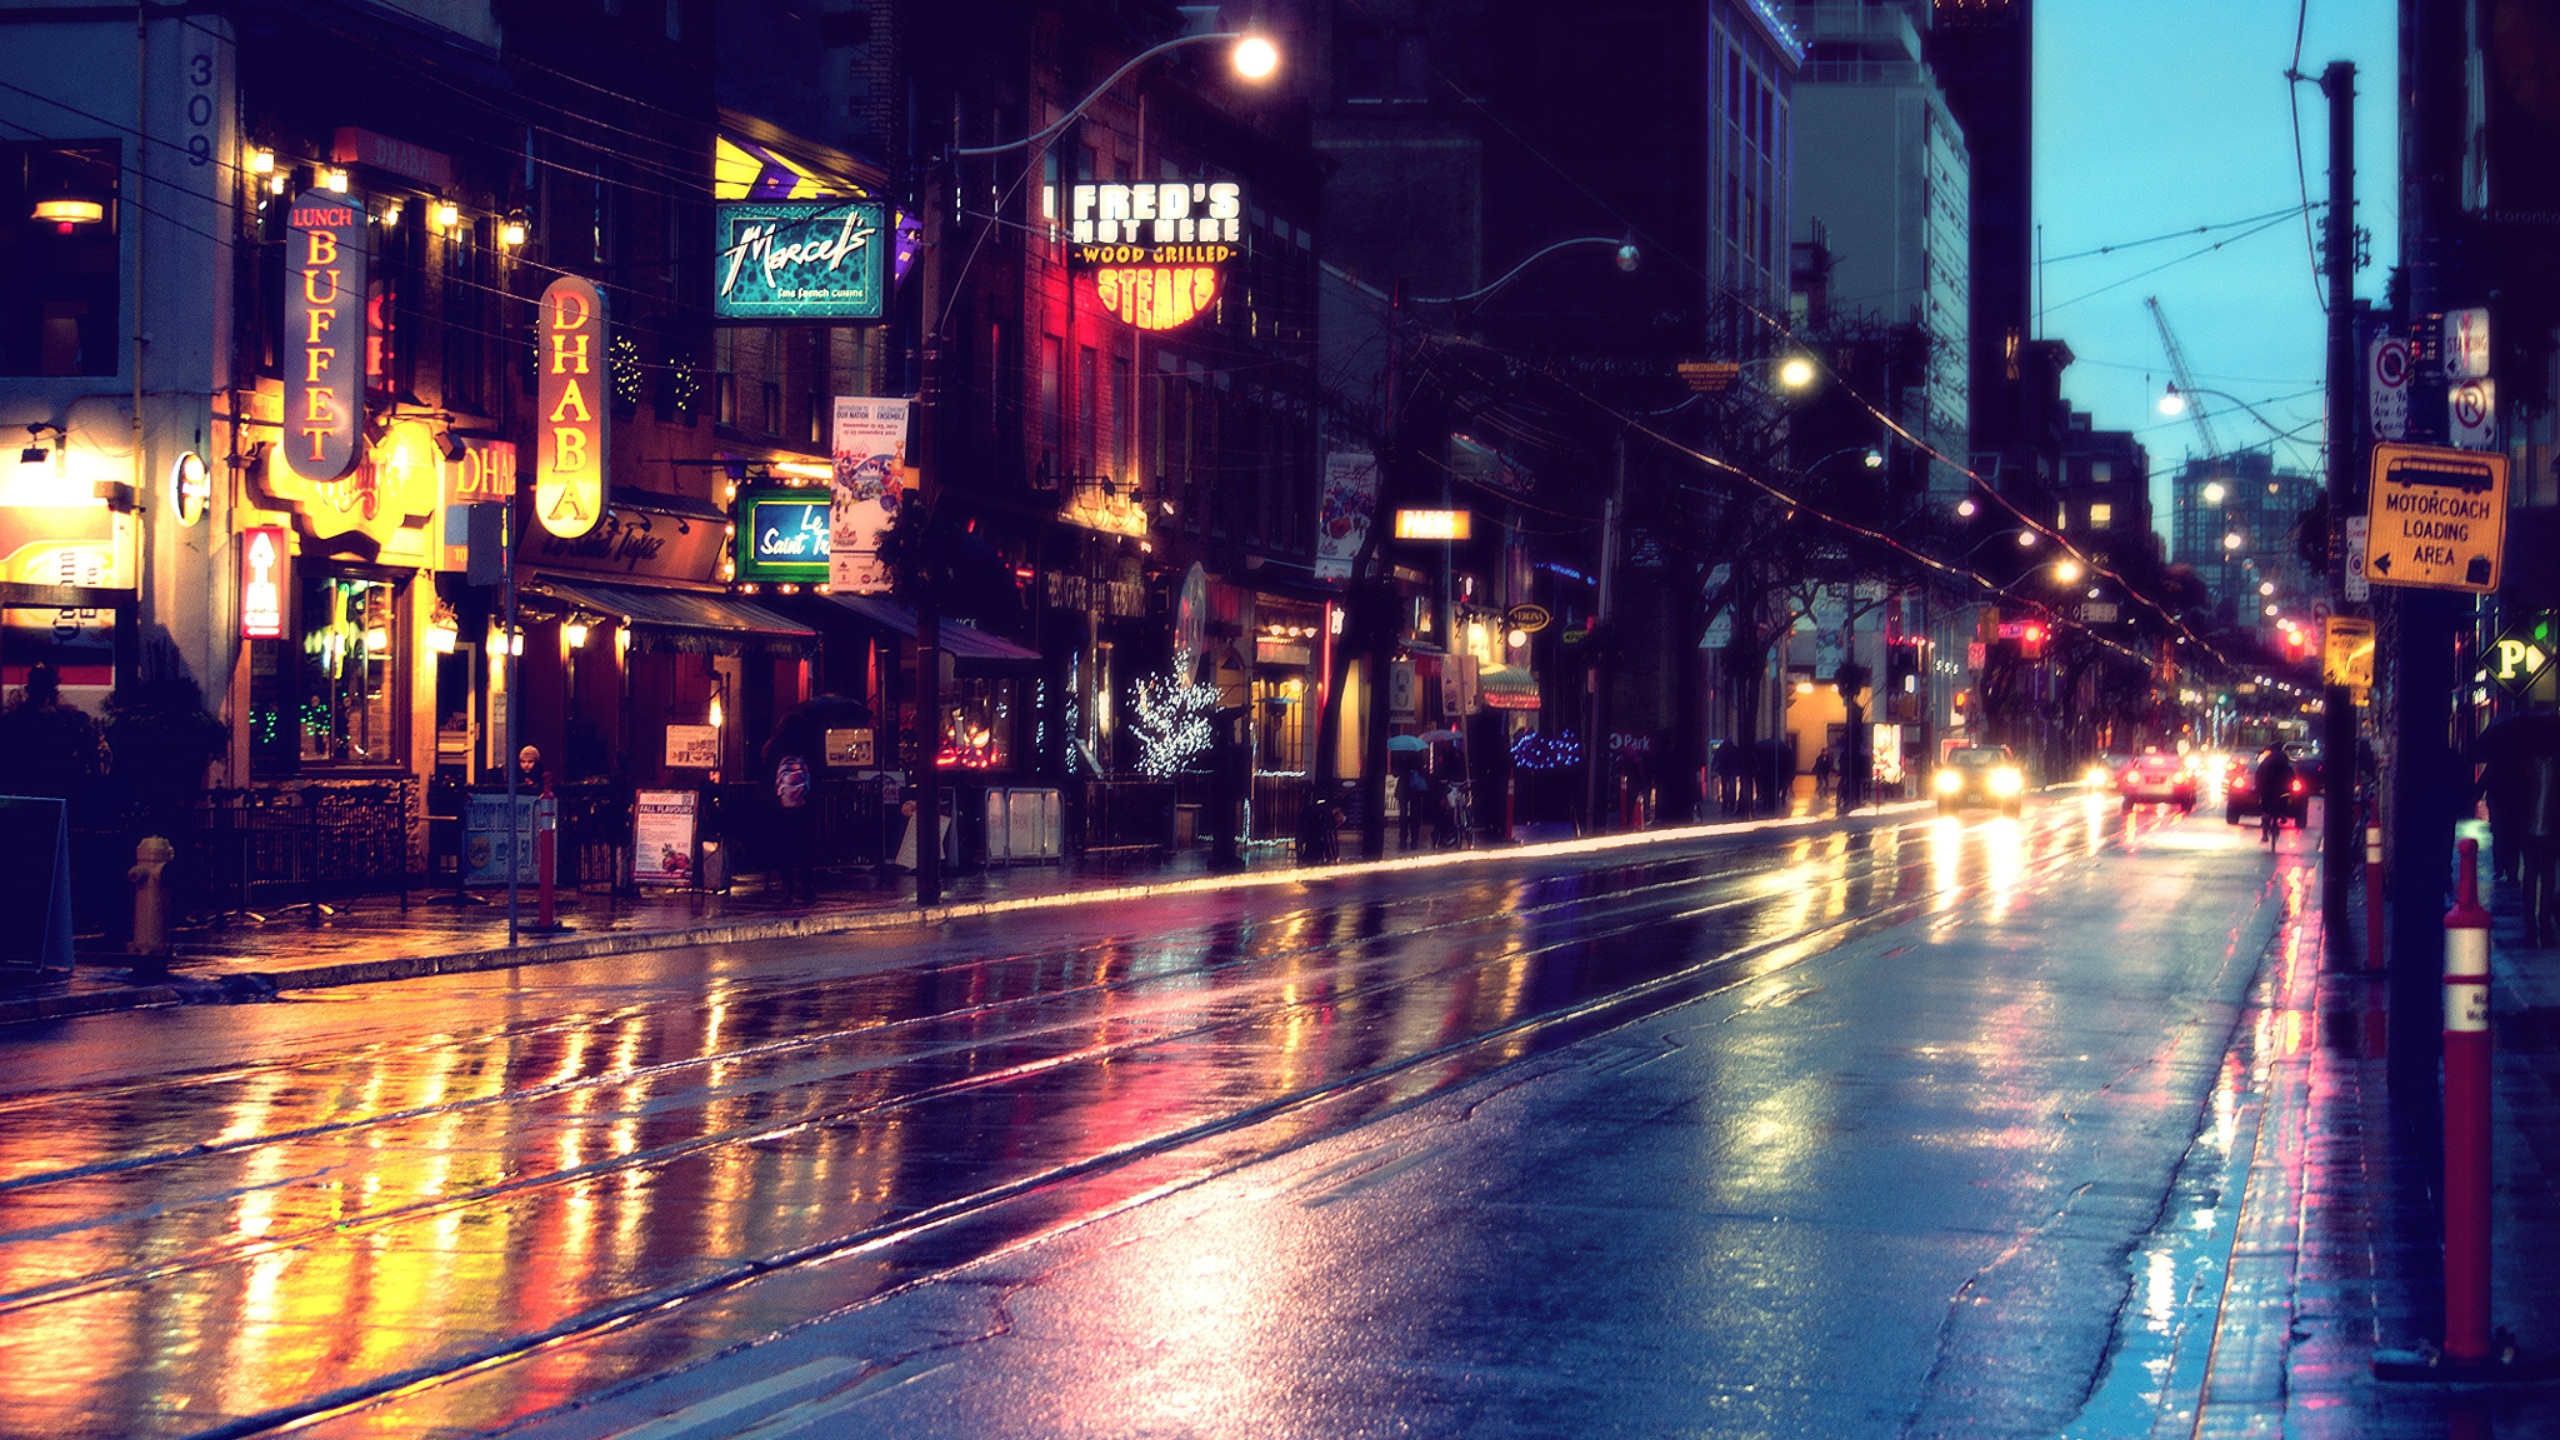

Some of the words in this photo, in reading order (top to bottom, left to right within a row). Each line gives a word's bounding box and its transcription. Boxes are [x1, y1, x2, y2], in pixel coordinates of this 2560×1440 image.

[188, 54, 214, 168] 309
[376, 136, 431, 179] DHABA
[1073, 182, 1241, 219] FRED'S
[293, 208, 353, 229] LUNCH
[1073, 218, 1141, 244] NOT
[1154, 218, 1241, 243] HERE
[721, 210, 876, 298] Marcel's
[1096, 267, 1216, 331] STEAKS
[304, 230, 337, 462] BUFFET
[2446, 333, 2487, 354] STADING
[550, 291, 592, 520] DHABA
[801, 505, 824, 532] Le
[2386, 492, 2491, 520] MOTORCOACH
[760, 527, 810, 555] Saint
[813, 529, 831, 556] Tr
[2403, 520, 2469, 543] LOADING
[2413, 546, 2455, 567] AREA
[2497, 639, 2526, 679] P
[639, 804, 655, 814] FALL
[657, 804, 694, 815] FLAVOURS
